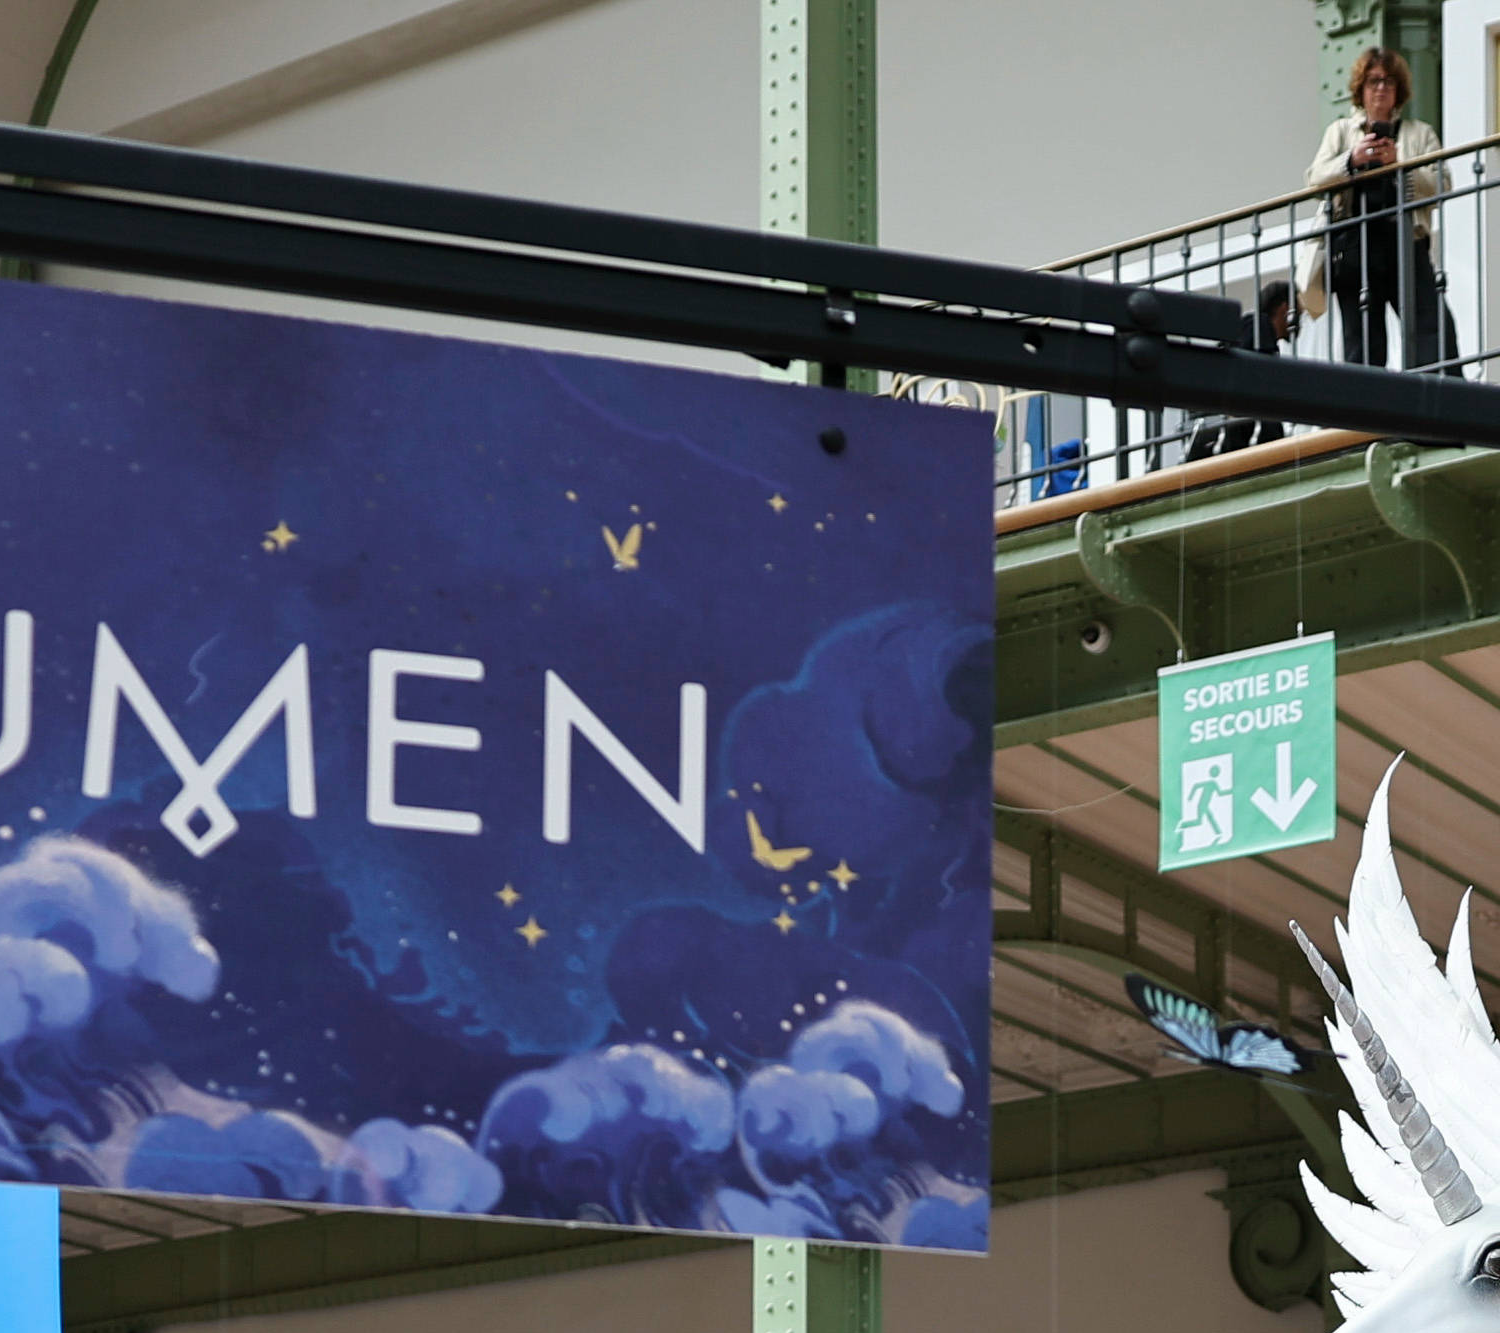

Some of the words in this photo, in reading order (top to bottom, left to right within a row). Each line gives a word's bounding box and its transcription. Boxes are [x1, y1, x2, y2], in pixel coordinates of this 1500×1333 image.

[1183, 672, 1271, 711] SORTIE
[1276, 665, 1309, 692] DE
[1189, 700, 1303, 743] SECOURS
